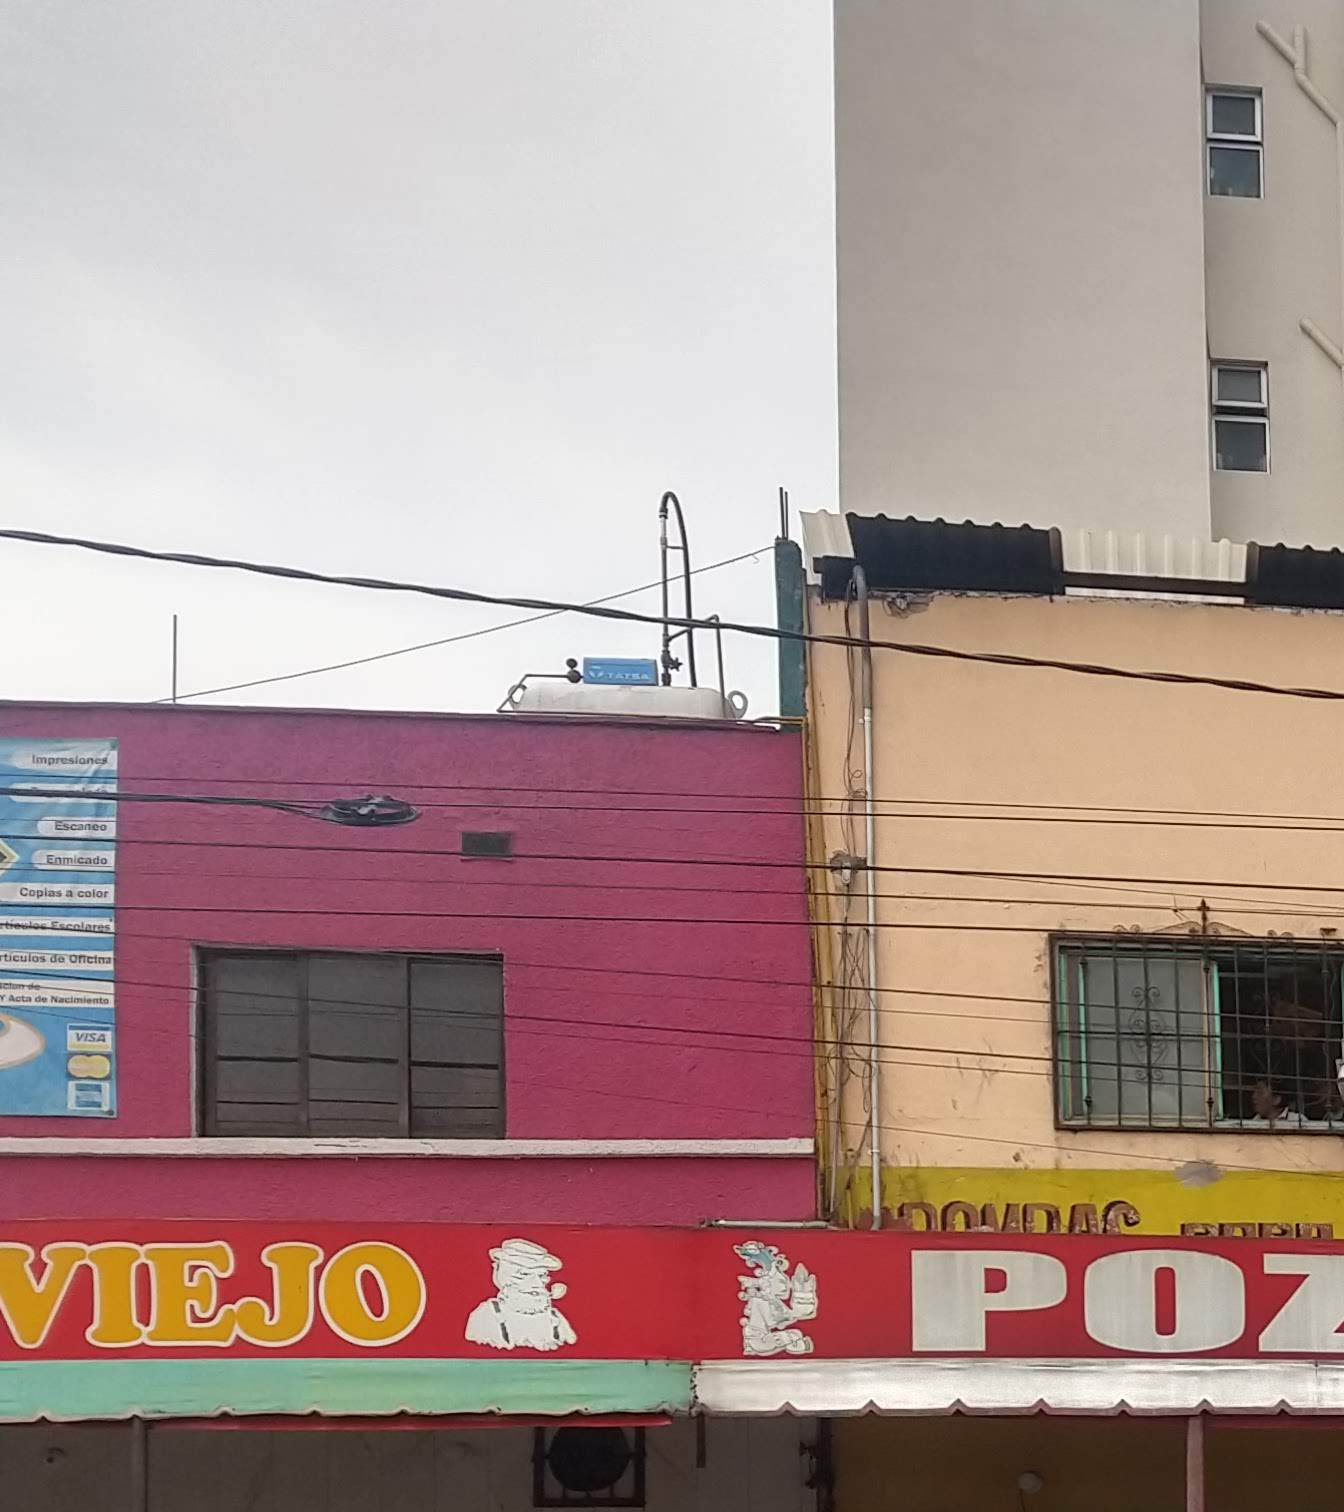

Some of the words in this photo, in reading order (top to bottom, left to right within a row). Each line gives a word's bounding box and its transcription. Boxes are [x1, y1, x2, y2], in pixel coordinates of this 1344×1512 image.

[32, 754, 108, 766] Impresiones
[54, 821, 108, 832] Escaneo
[46, 854, 108, 866] Enmicado
[20, 887, 62, 899] Copias
[65, 891, 73, 899] a
[77, 888, 109, 899] color
[51, 921, 111, 932] Escolares
[50, 953, 65, 963] de
[69, 954, 111, 965] Oficina
[9, 994, 32, 1003] Acta
[35, 994, 48, 1004] de
[50, 995, 110, 1005] Nacimiento
[76, 1032, 106, 1043] VISA
[0, 1241, 426, 1348] VIEJO
